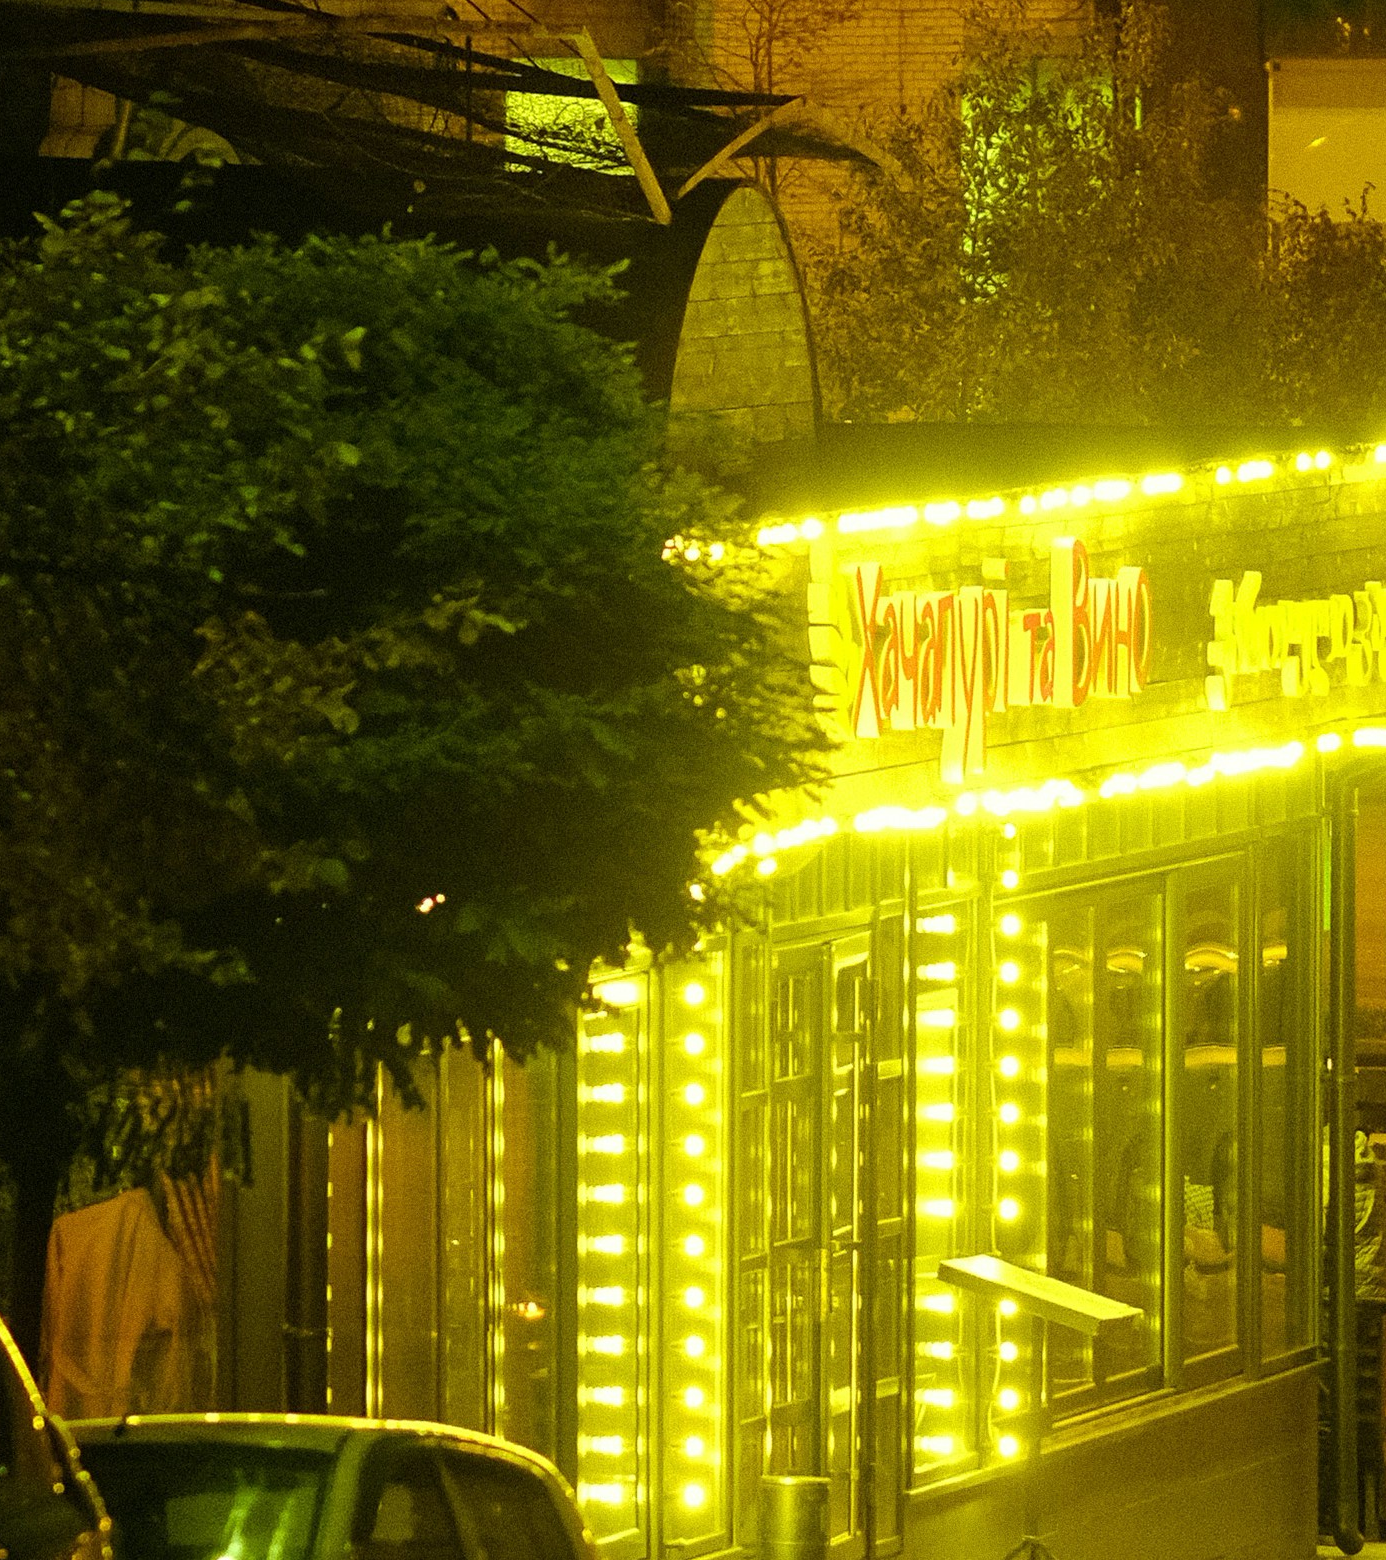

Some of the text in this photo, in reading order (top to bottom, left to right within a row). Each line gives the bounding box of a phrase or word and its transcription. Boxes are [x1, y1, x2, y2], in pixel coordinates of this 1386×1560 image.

[853, 558, 1010, 782] Хачапурі
[1017, 610, 1055, 705] та
[1061, 537, 1153, 708] Вино
